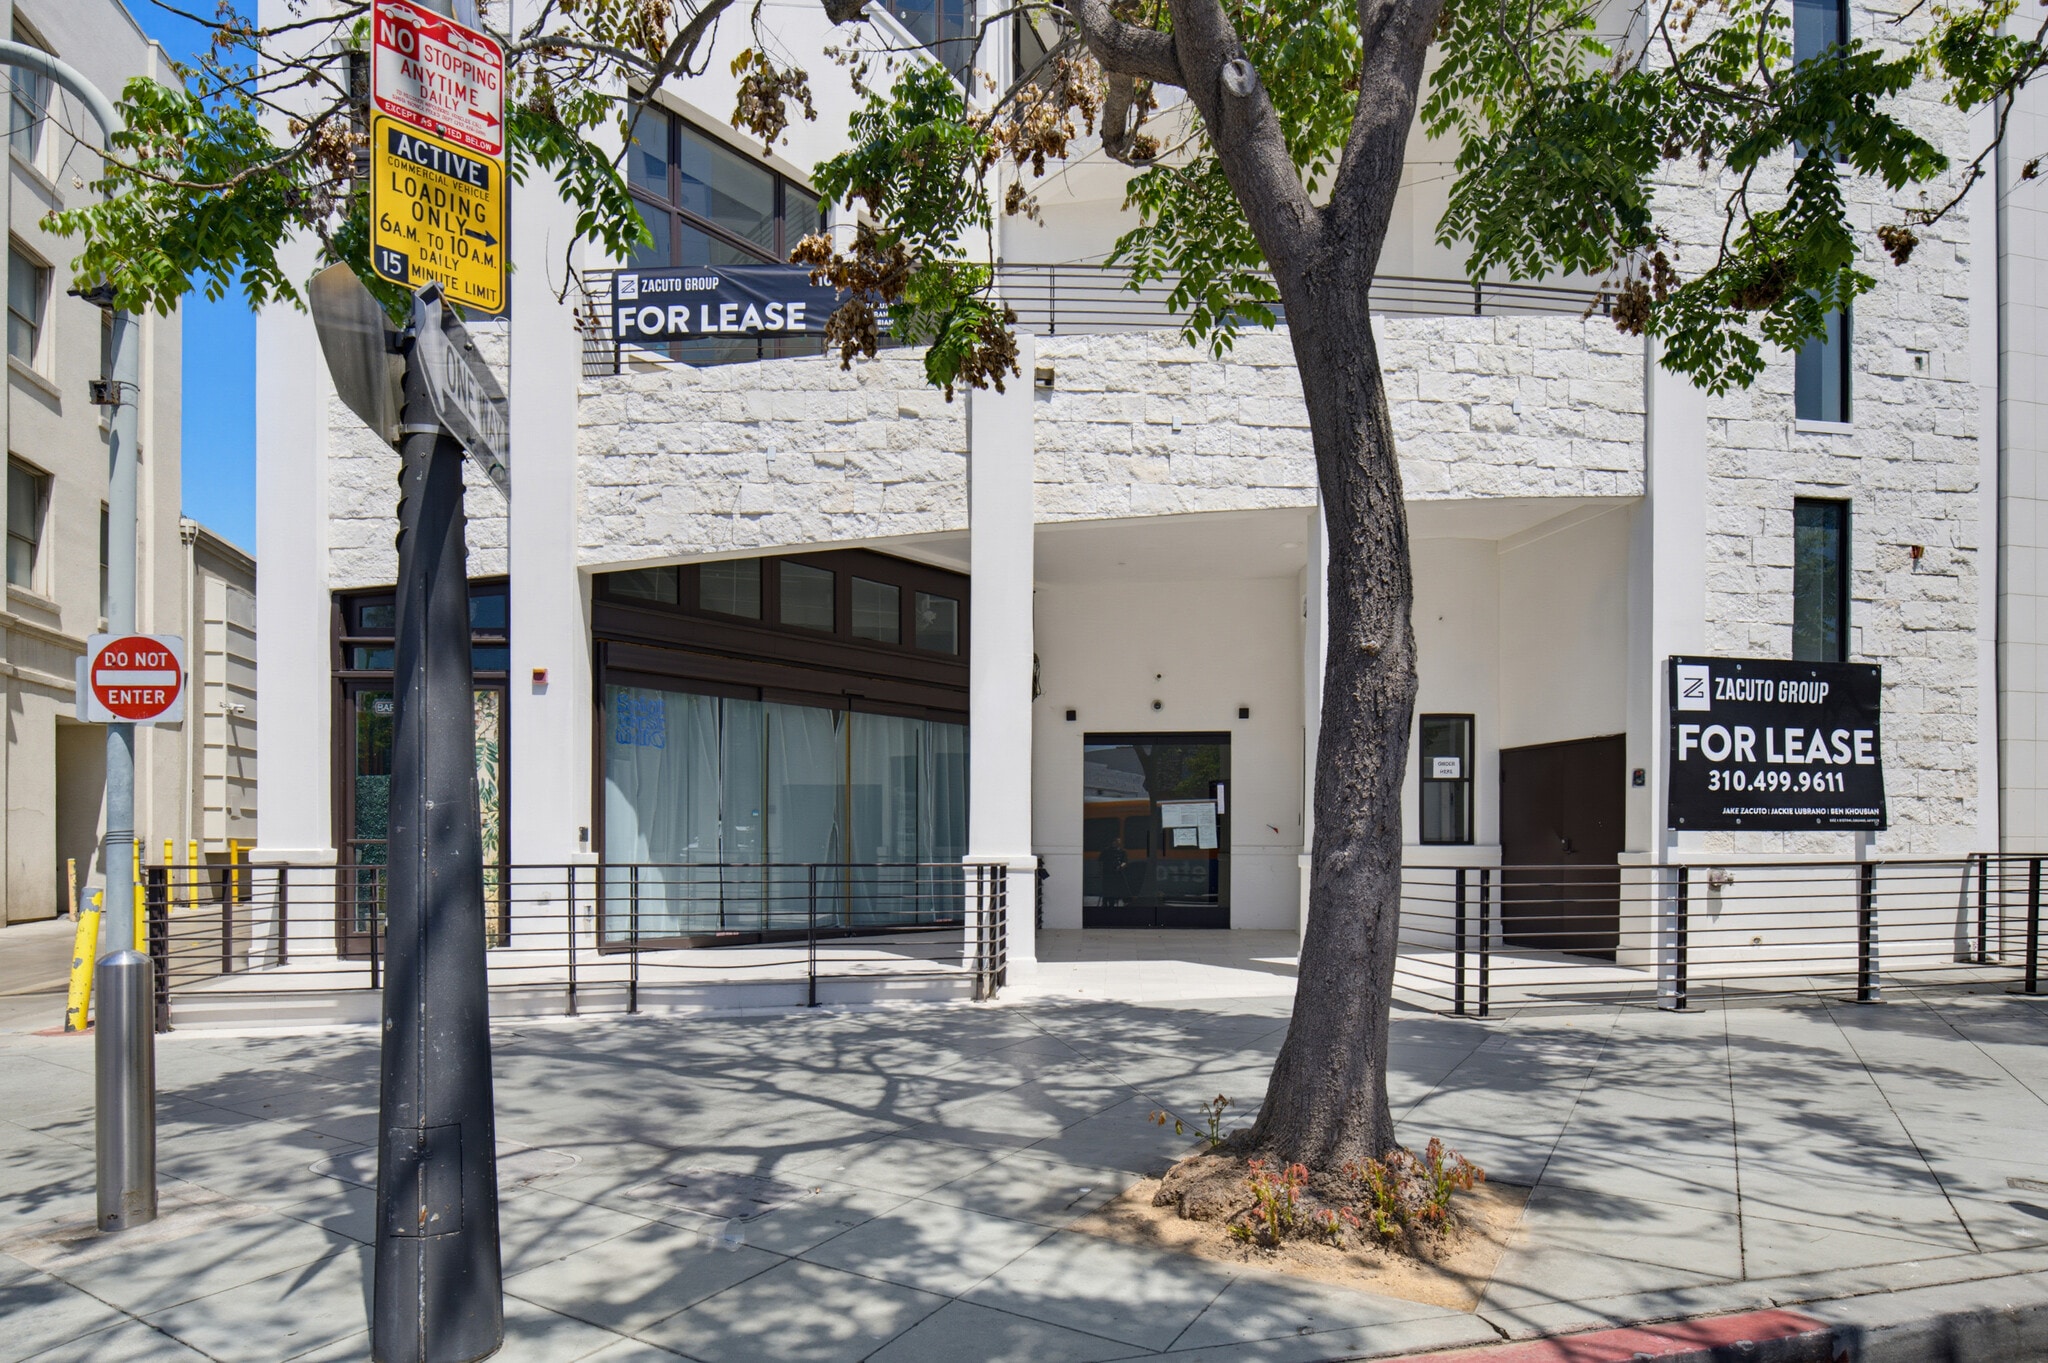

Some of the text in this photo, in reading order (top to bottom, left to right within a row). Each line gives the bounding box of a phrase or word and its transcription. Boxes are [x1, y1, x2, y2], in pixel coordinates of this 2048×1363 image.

[381, 19, 496, 90] NO STOPPING
[401, 60, 478, 107] ANYTIME
[420, 85, 459, 112] DAILY
[385, 102, 417, 121] EXCEPT
[421, 117, 432, 128] AS
[465, 134, 492, 151] BELOW
[397, 134, 482, 186] ACTIVE
[387, 155, 490, 202] COMMERCIAL VEHICLE
[392, 171, 486, 223] LOADING
[412, 201, 467, 236] ONLY
[427, 232, 444, 250] TO
[382, 251, 497, 302] 15 MINUTE LIMIT
[420, 247, 459, 271] DAILY
[641, 277, 683, 293] ZACUTO
[684, 276, 719, 292] GROUP
[619, 302, 806, 337] FOR LEASE
[447, 345, 476, 421] ONE
[104, 652, 168, 667] DO NOT
[108, 690, 166, 704] ENTER
[1715, 677, 1774, 702] ZACUTO
[1778, 680, 1829, 704] GROUP
[1678, 724, 1875, 765] FOR LEASE
[1707, 769, 1845, 792] 310.499.9611
